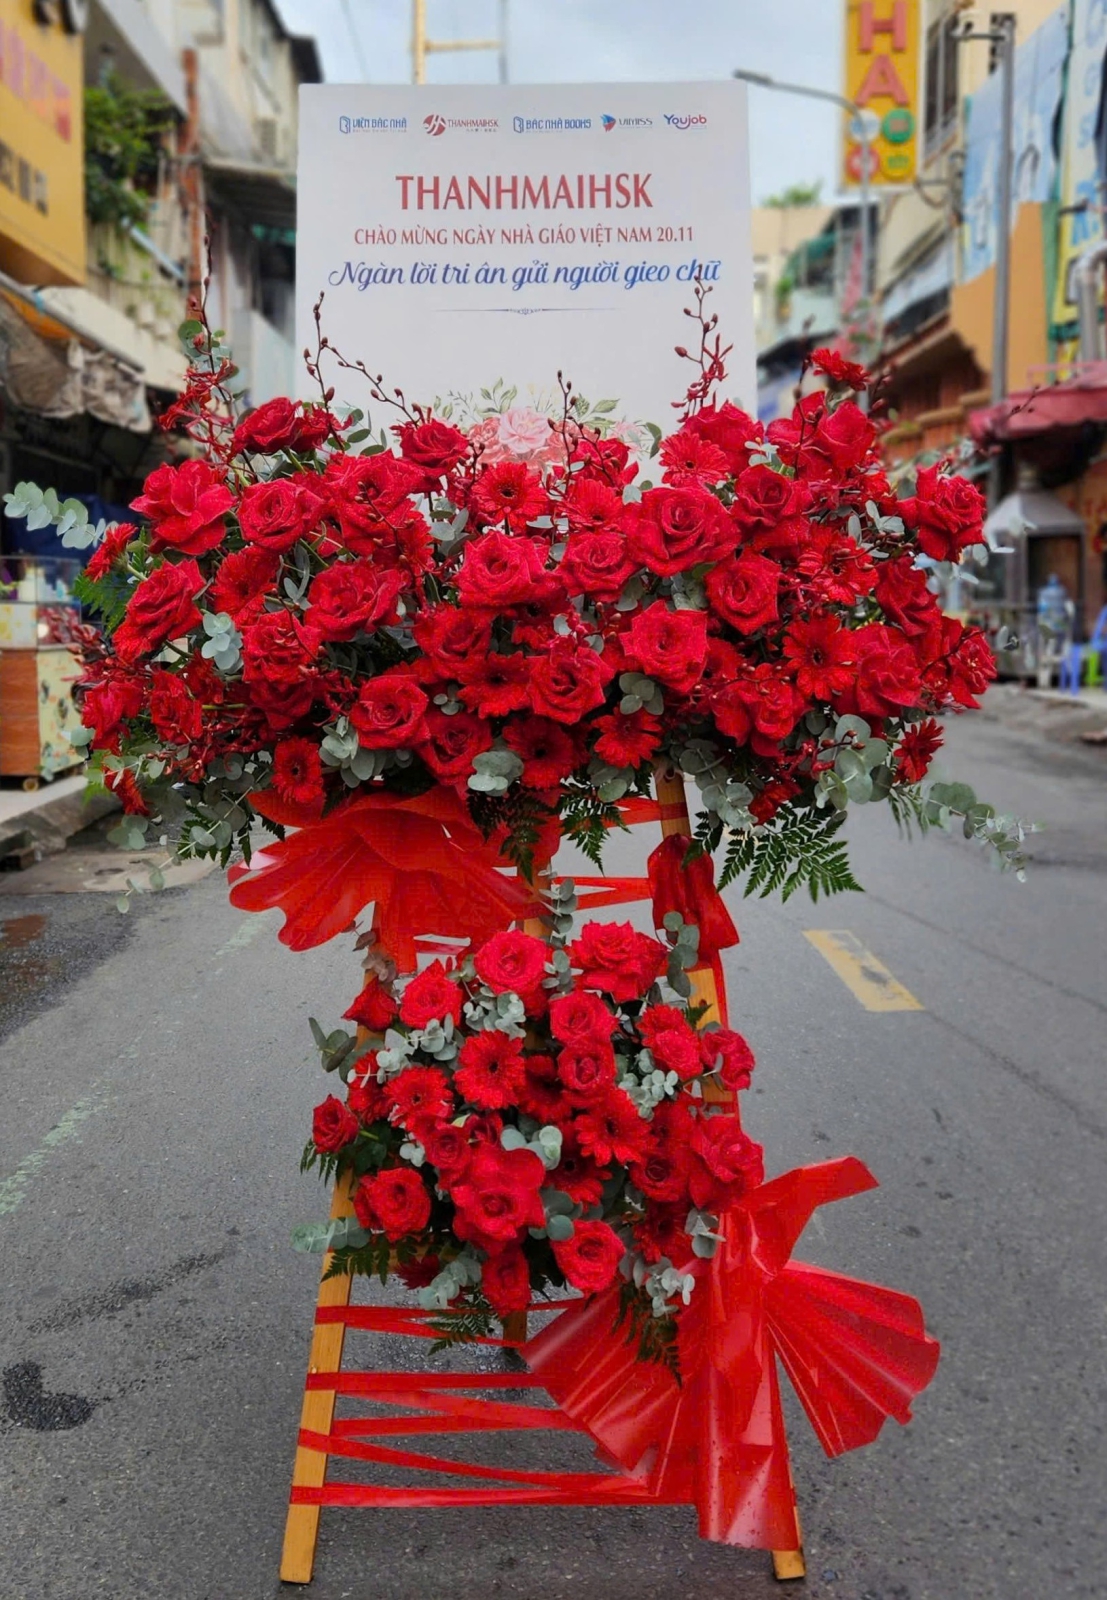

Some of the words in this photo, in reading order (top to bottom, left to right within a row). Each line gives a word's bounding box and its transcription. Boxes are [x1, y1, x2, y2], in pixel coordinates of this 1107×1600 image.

[448, 119, 498, 128] THANHMAIHSK
[663, 113, 708, 130] Youjob
[395, 173, 653, 210] THANHMAIHSK
[354, 223, 397, 245] CHÀO
[400, 223, 448, 245] MỪNG
[452, 223, 496, 245] NGÀY
[501, 223, 534, 245] NHÀ
[538, 223, 576, 244] GIÁO
[580, 222, 613, 248] VIỆT
[617, 226, 653, 243] NAM
[656, 226, 694, 242] 20.11
[328, 261, 405, 292] Ngàn
[409, 261, 438, 285] lời
[441, 262, 471, 285] tri
[474, 261, 508, 285] ân
[511, 259, 550, 292] gửi
[553, 260, 620, 291] người
[623, 260, 671, 290] gieo
[675, 258, 722, 282] chữ
